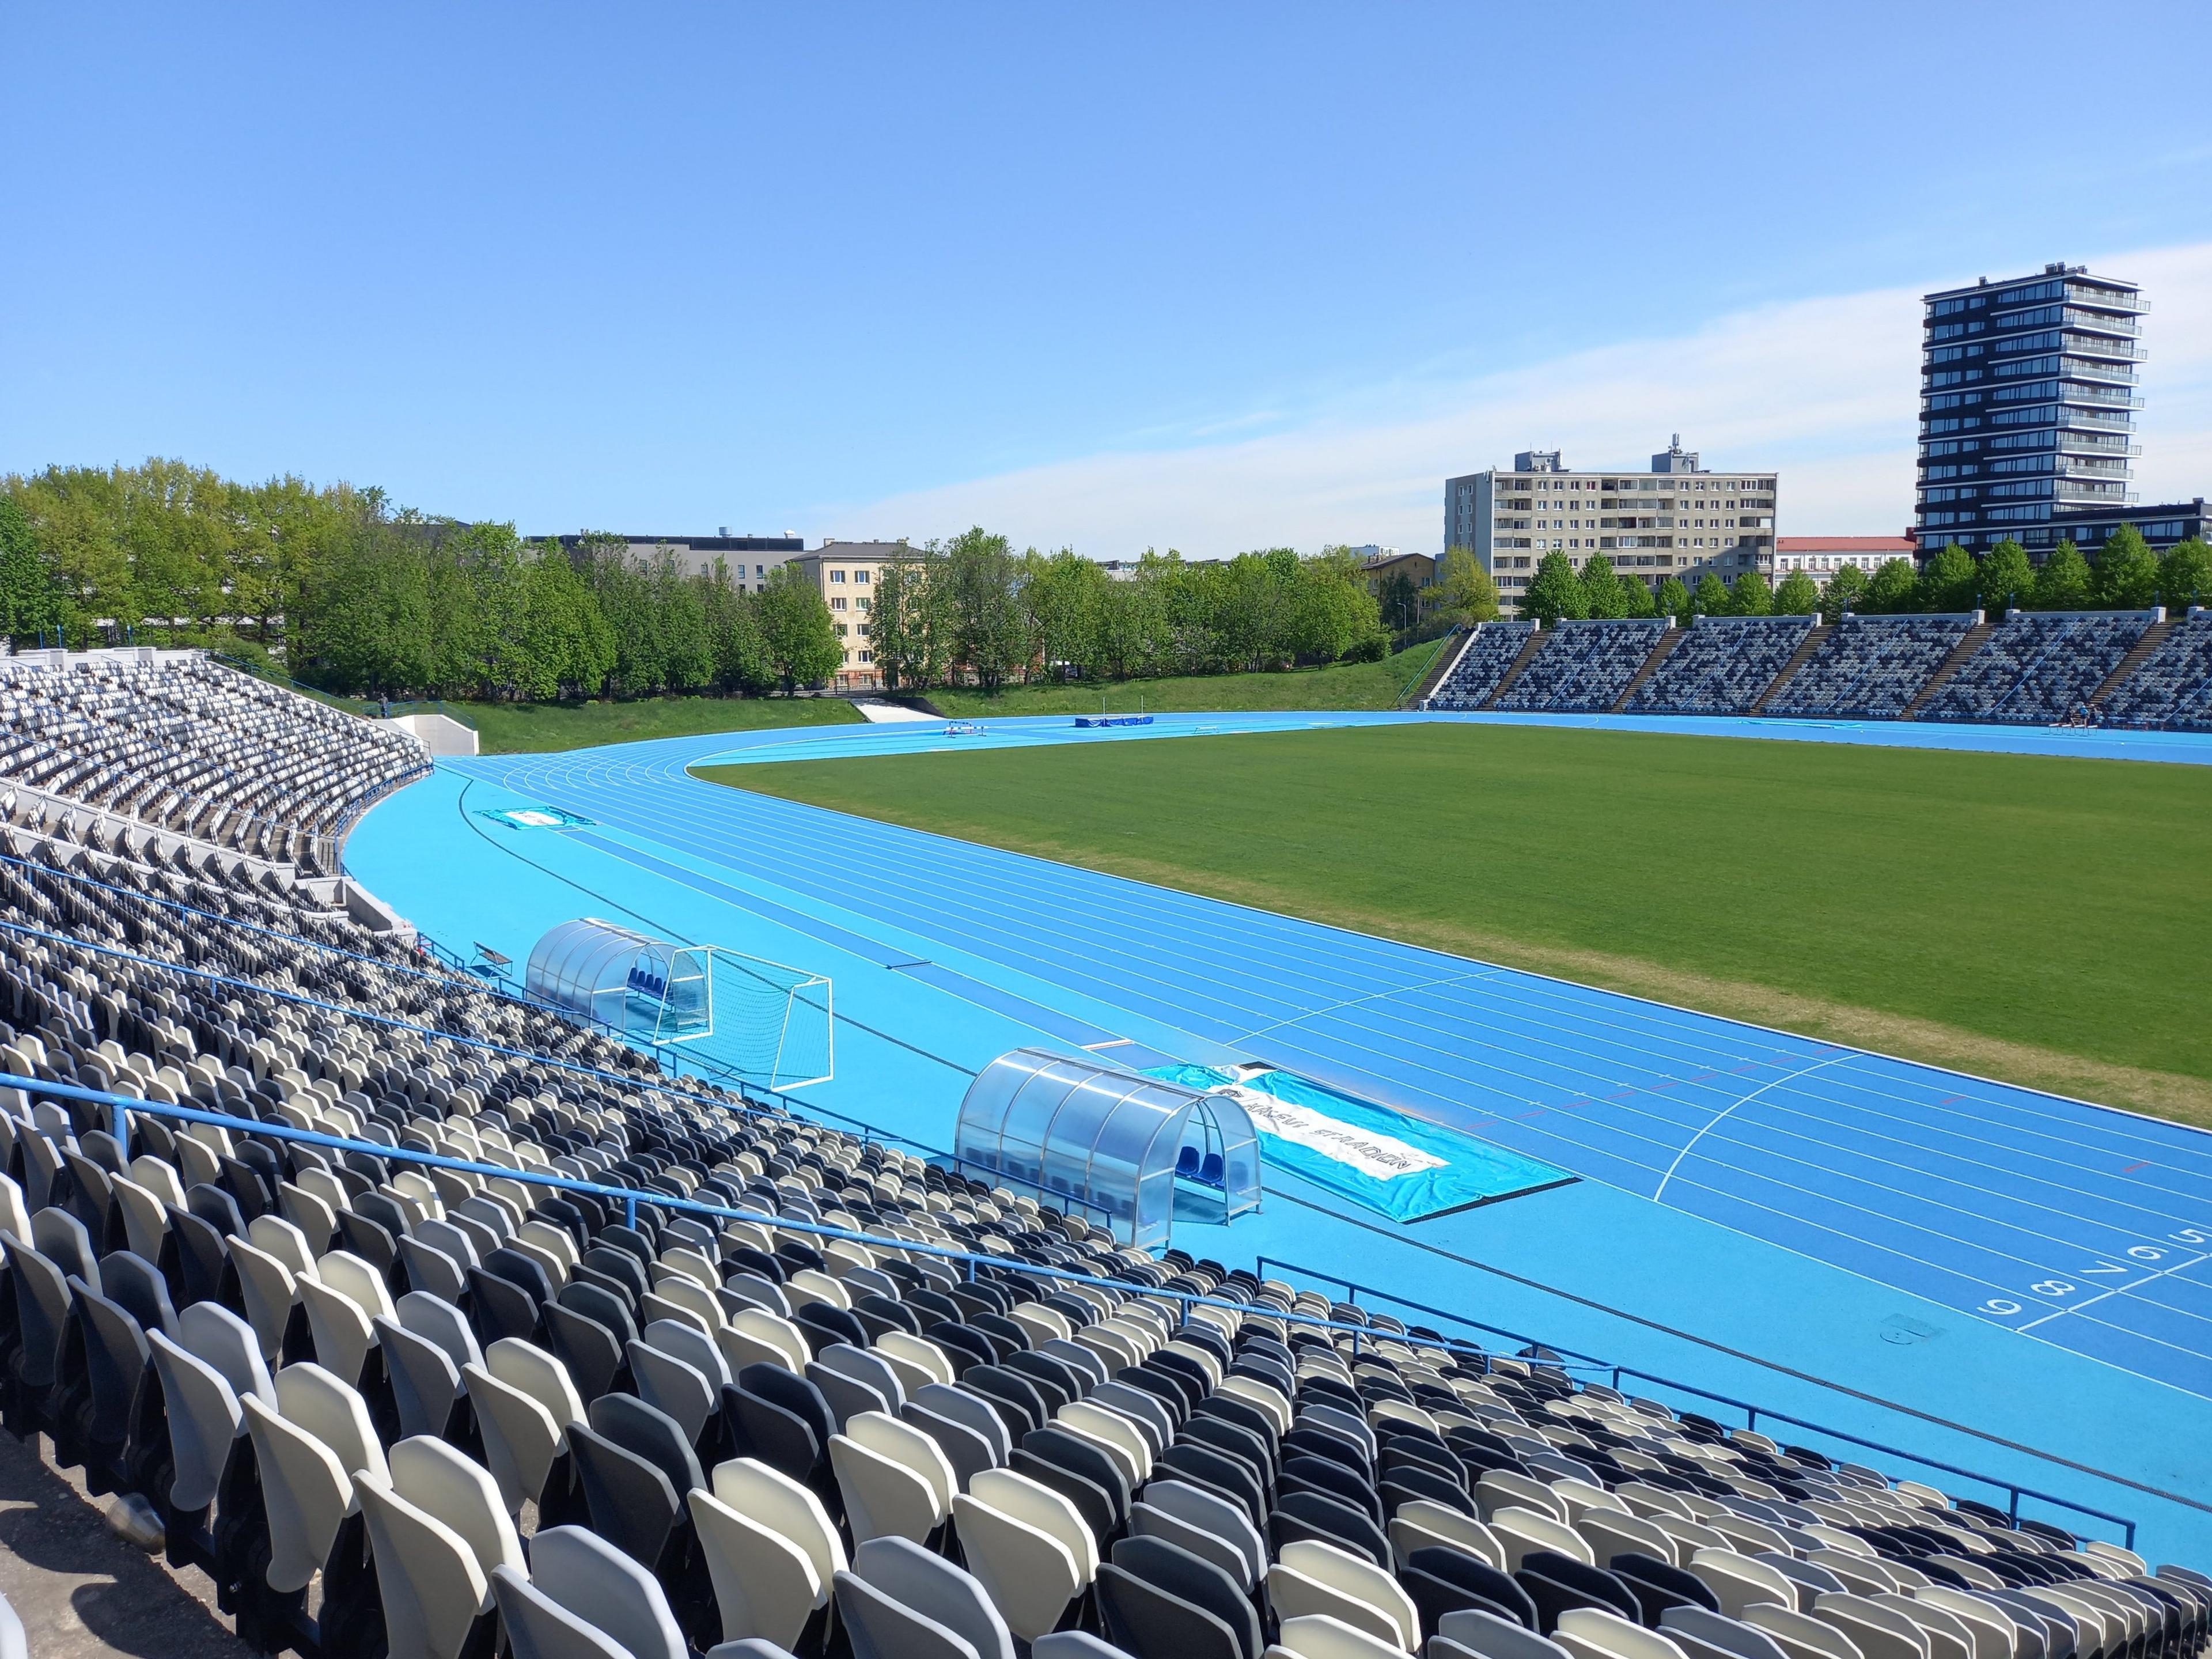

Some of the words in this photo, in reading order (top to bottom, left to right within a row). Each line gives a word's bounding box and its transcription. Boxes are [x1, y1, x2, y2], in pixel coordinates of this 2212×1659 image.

[1309, 1129, 1411, 1169] STAADION
[2168, 1228, 2212, 1243] 5
[2127, 1246, 2169, 1260] 6
[2078, 1260, 2128, 1274] 7
[2031, 1280, 2076, 1296] 8
[1976, 1299, 2022, 1315] 9
